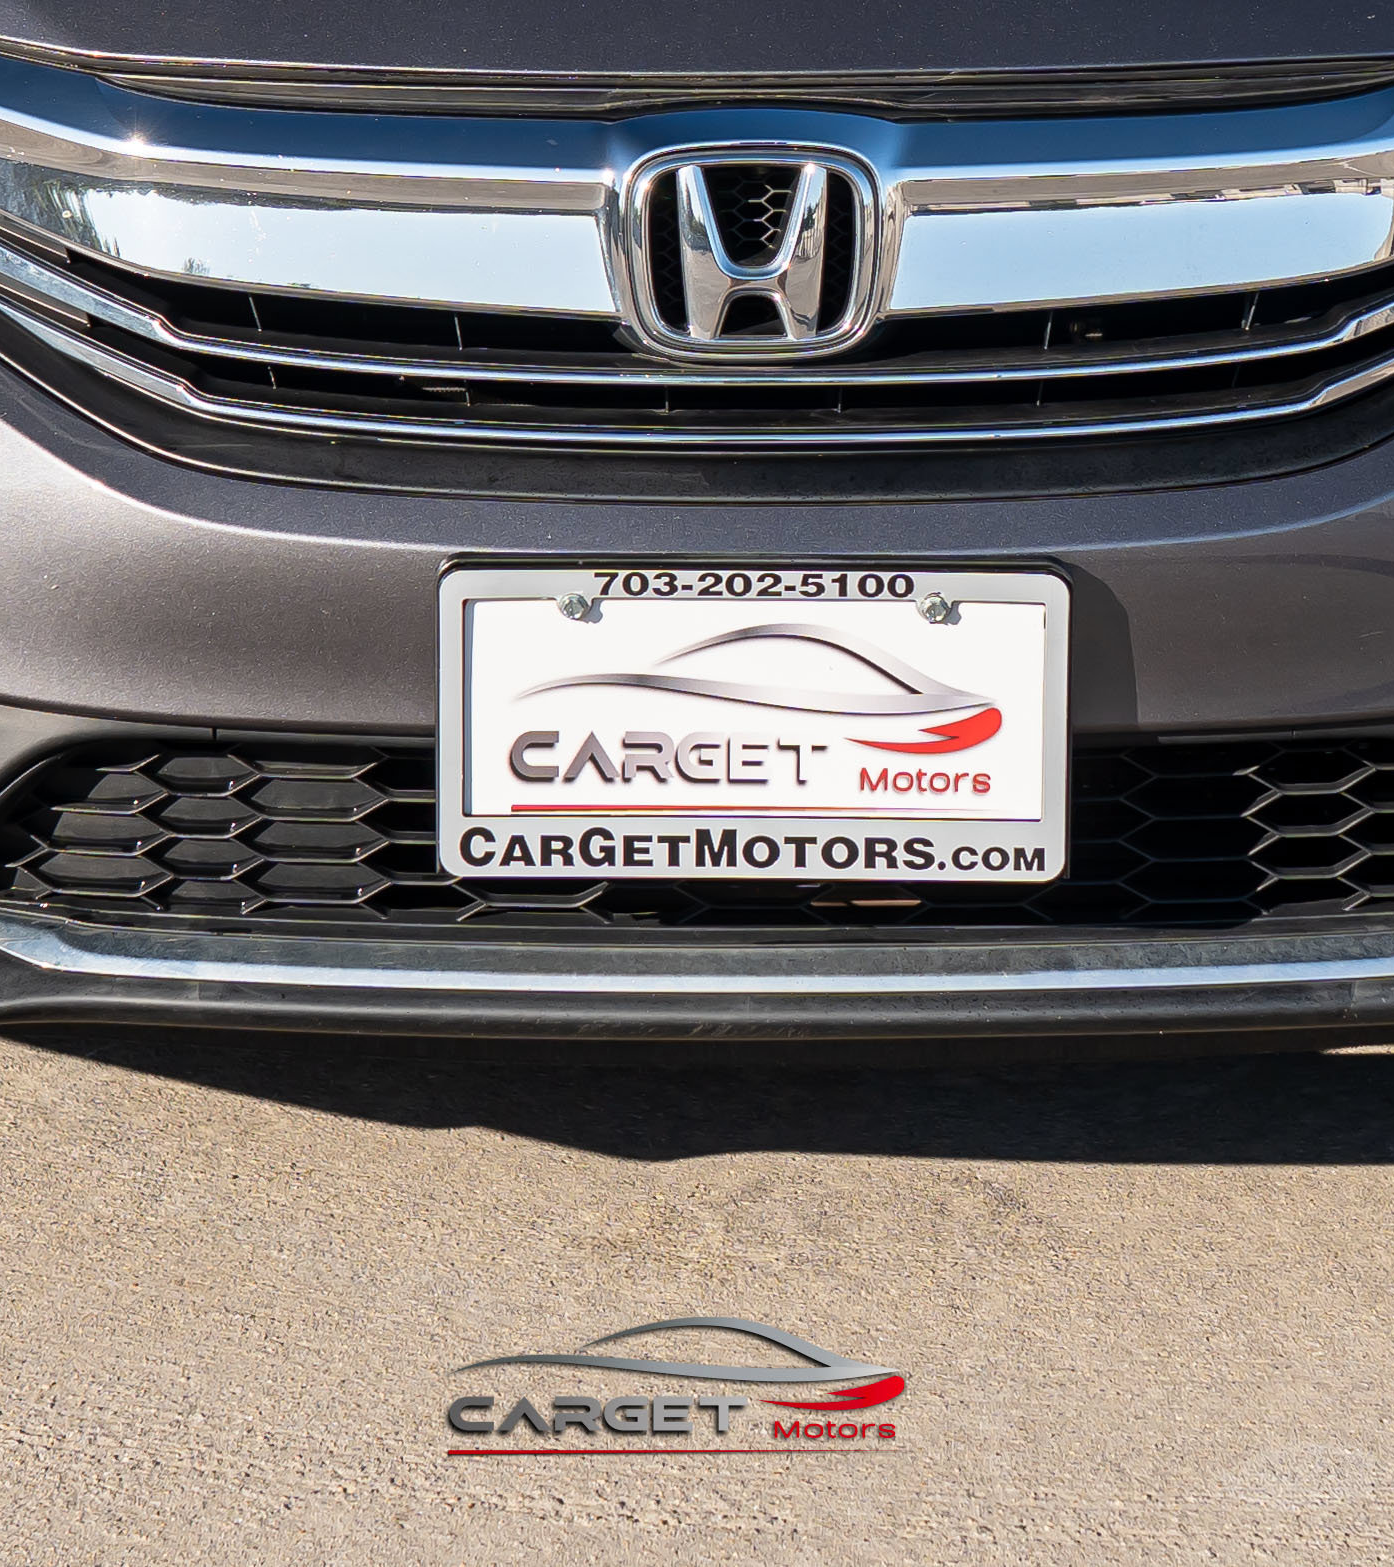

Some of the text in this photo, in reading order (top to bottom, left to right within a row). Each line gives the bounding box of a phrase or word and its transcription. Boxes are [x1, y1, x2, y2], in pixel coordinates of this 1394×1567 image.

[593, 571, 916, 598] 703-202-5100
[510, 730, 992, 795] CARGET Motors
